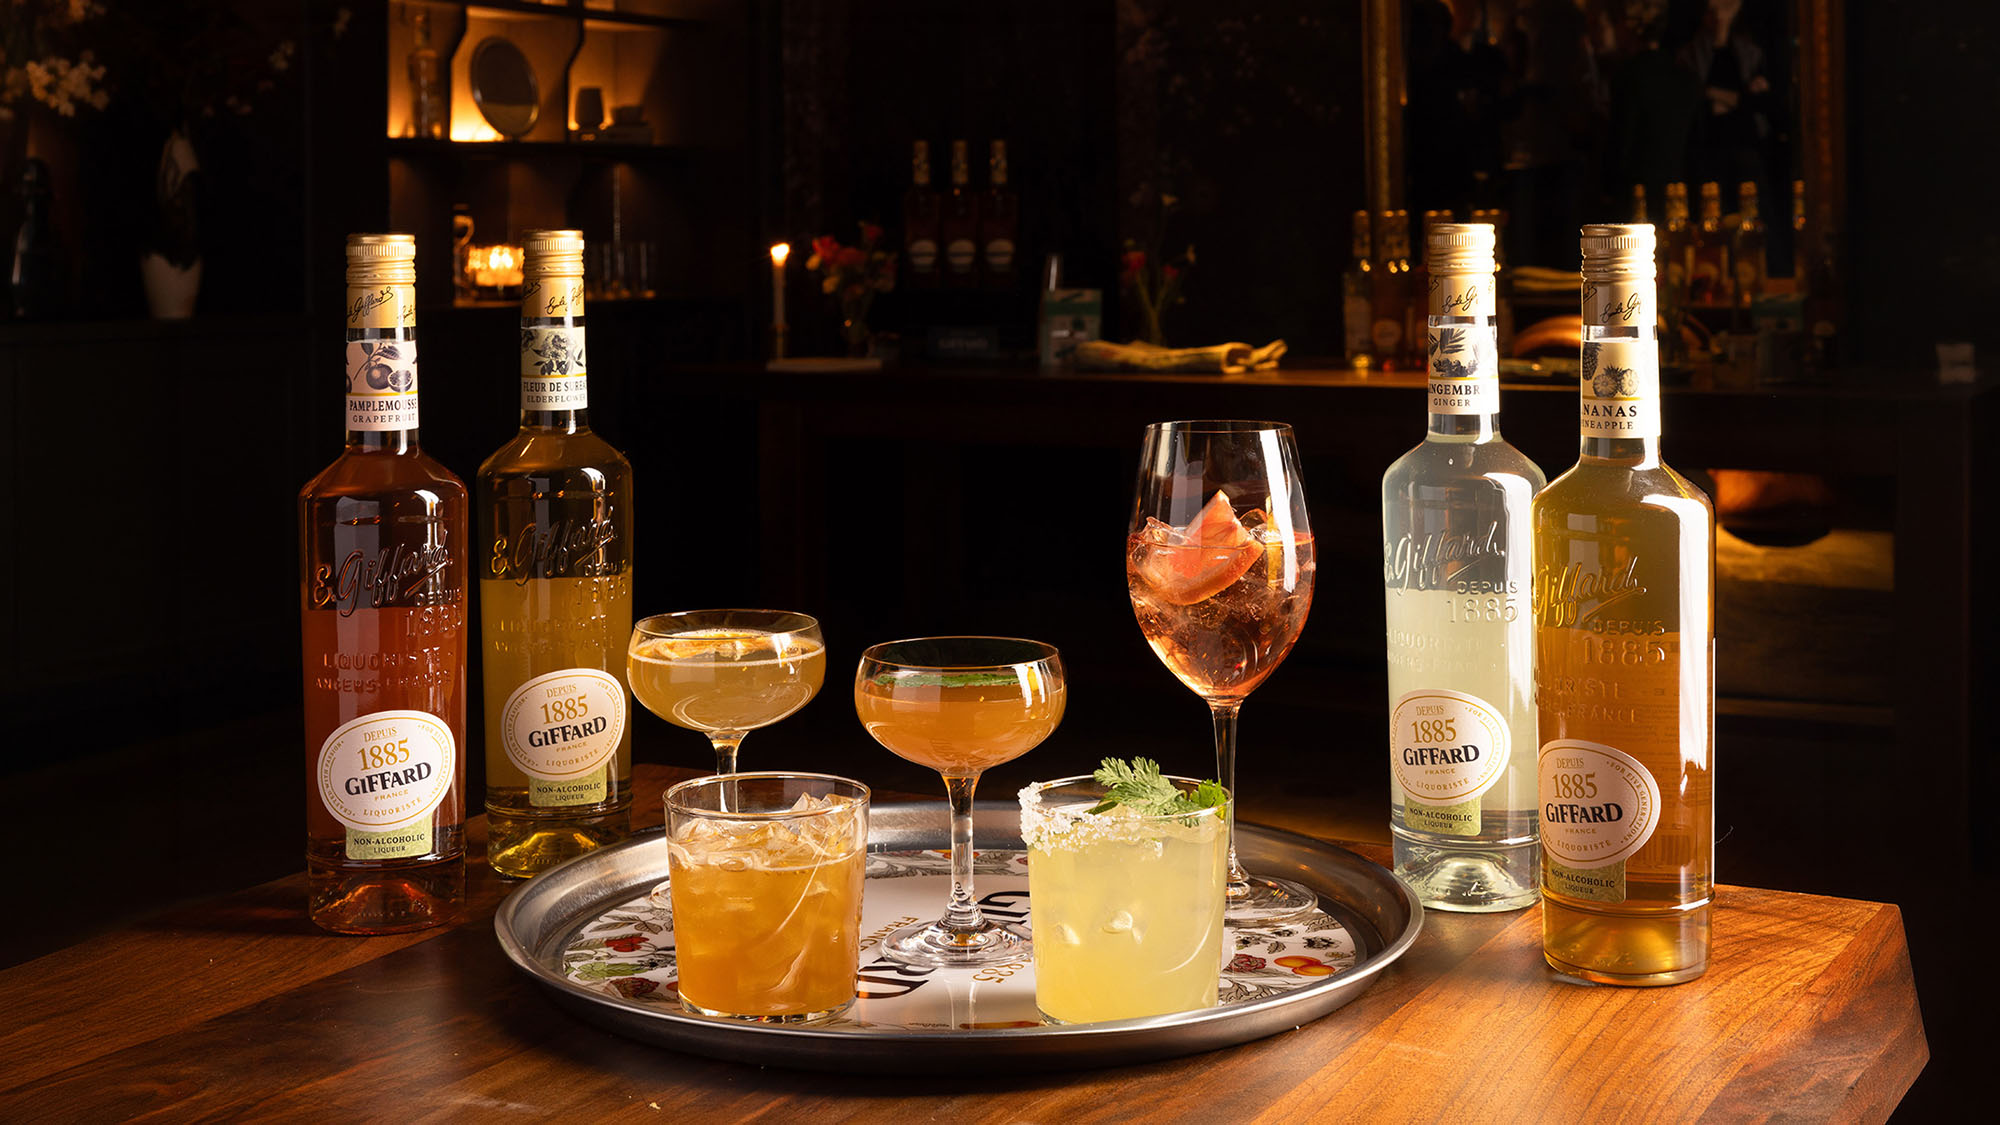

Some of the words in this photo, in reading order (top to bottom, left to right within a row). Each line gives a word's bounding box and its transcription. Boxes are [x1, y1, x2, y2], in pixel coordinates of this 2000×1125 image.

[523, 381, 546, 393] FLEUR
[549, 382, 562, 392] DE
[1433, 397, 1471, 407] GINGER
[1583, 403, 1637, 417] NANAS
[352, 413, 415, 423] GRAPEFRUIT
[1456, 579, 1519, 595] DEPUIS
[1446, 598, 1520, 624] 1885
[1592, 619, 1666, 636] DEPUIS
[1582, 637, 1666, 666] 1885
[546, 683, 577, 698] DEPUIS
[540, 693, 588, 725] 1885
[1415, 704, 1445, 716] DEPUIS
[363, 727, 398, 743] DEPUIS
[528, 716, 607, 748] GIFFARD
[1411, 717, 1457, 744] 1885
[357, 737, 410, 771] 1885
[556, 741, 587, 753] FRANCE
[546, 749, 598, 767] LIQUORISTE
[1403, 744, 1480, 766] GIFFARD
[1556, 757, 1584, 769] DEPUIS
[1610, 762, 1625, 775] FOR
[344, 762, 432, 796] GIFFARD
[1424, 768, 1456, 776] FRANCE
[537, 782, 601, 793] NON-ALCOHOLIC
[1416, 777, 1469, 791] LIQUORISTE
[1552, 771, 1598, 799] 1885
[1626, 772, 1642, 790] FIVE
[374, 789, 409, 801] FRANCE
[555, 793, 585, 801] LIQUEUR
[363, 797, 421, 817] LIQUORISTE
[1409, 807, 1473, 822] NON-ALCOHOLIC
[1545, 802, 1623, 824] GIFFARD
[1624, 790, 1648, 841] GENERATIONS
[1424, 820, 1453, 829] LIQUEUR
[1565, 827, 1597, 835] FRANCE
[353, 833, 425, 846] NON-ALCOHOLIC
[1557, 839, 1612, 852] LIQUORISTE
[374, 846, 406, 854] LIQUEUR
[1551, 869, 1615, 888] NON-ALCOHOLIC
[1564, 884, 1594, 895] LIQUEUR
[860, 916, 919, 951] FRANC
[973, 957, 1031, 984] 885
